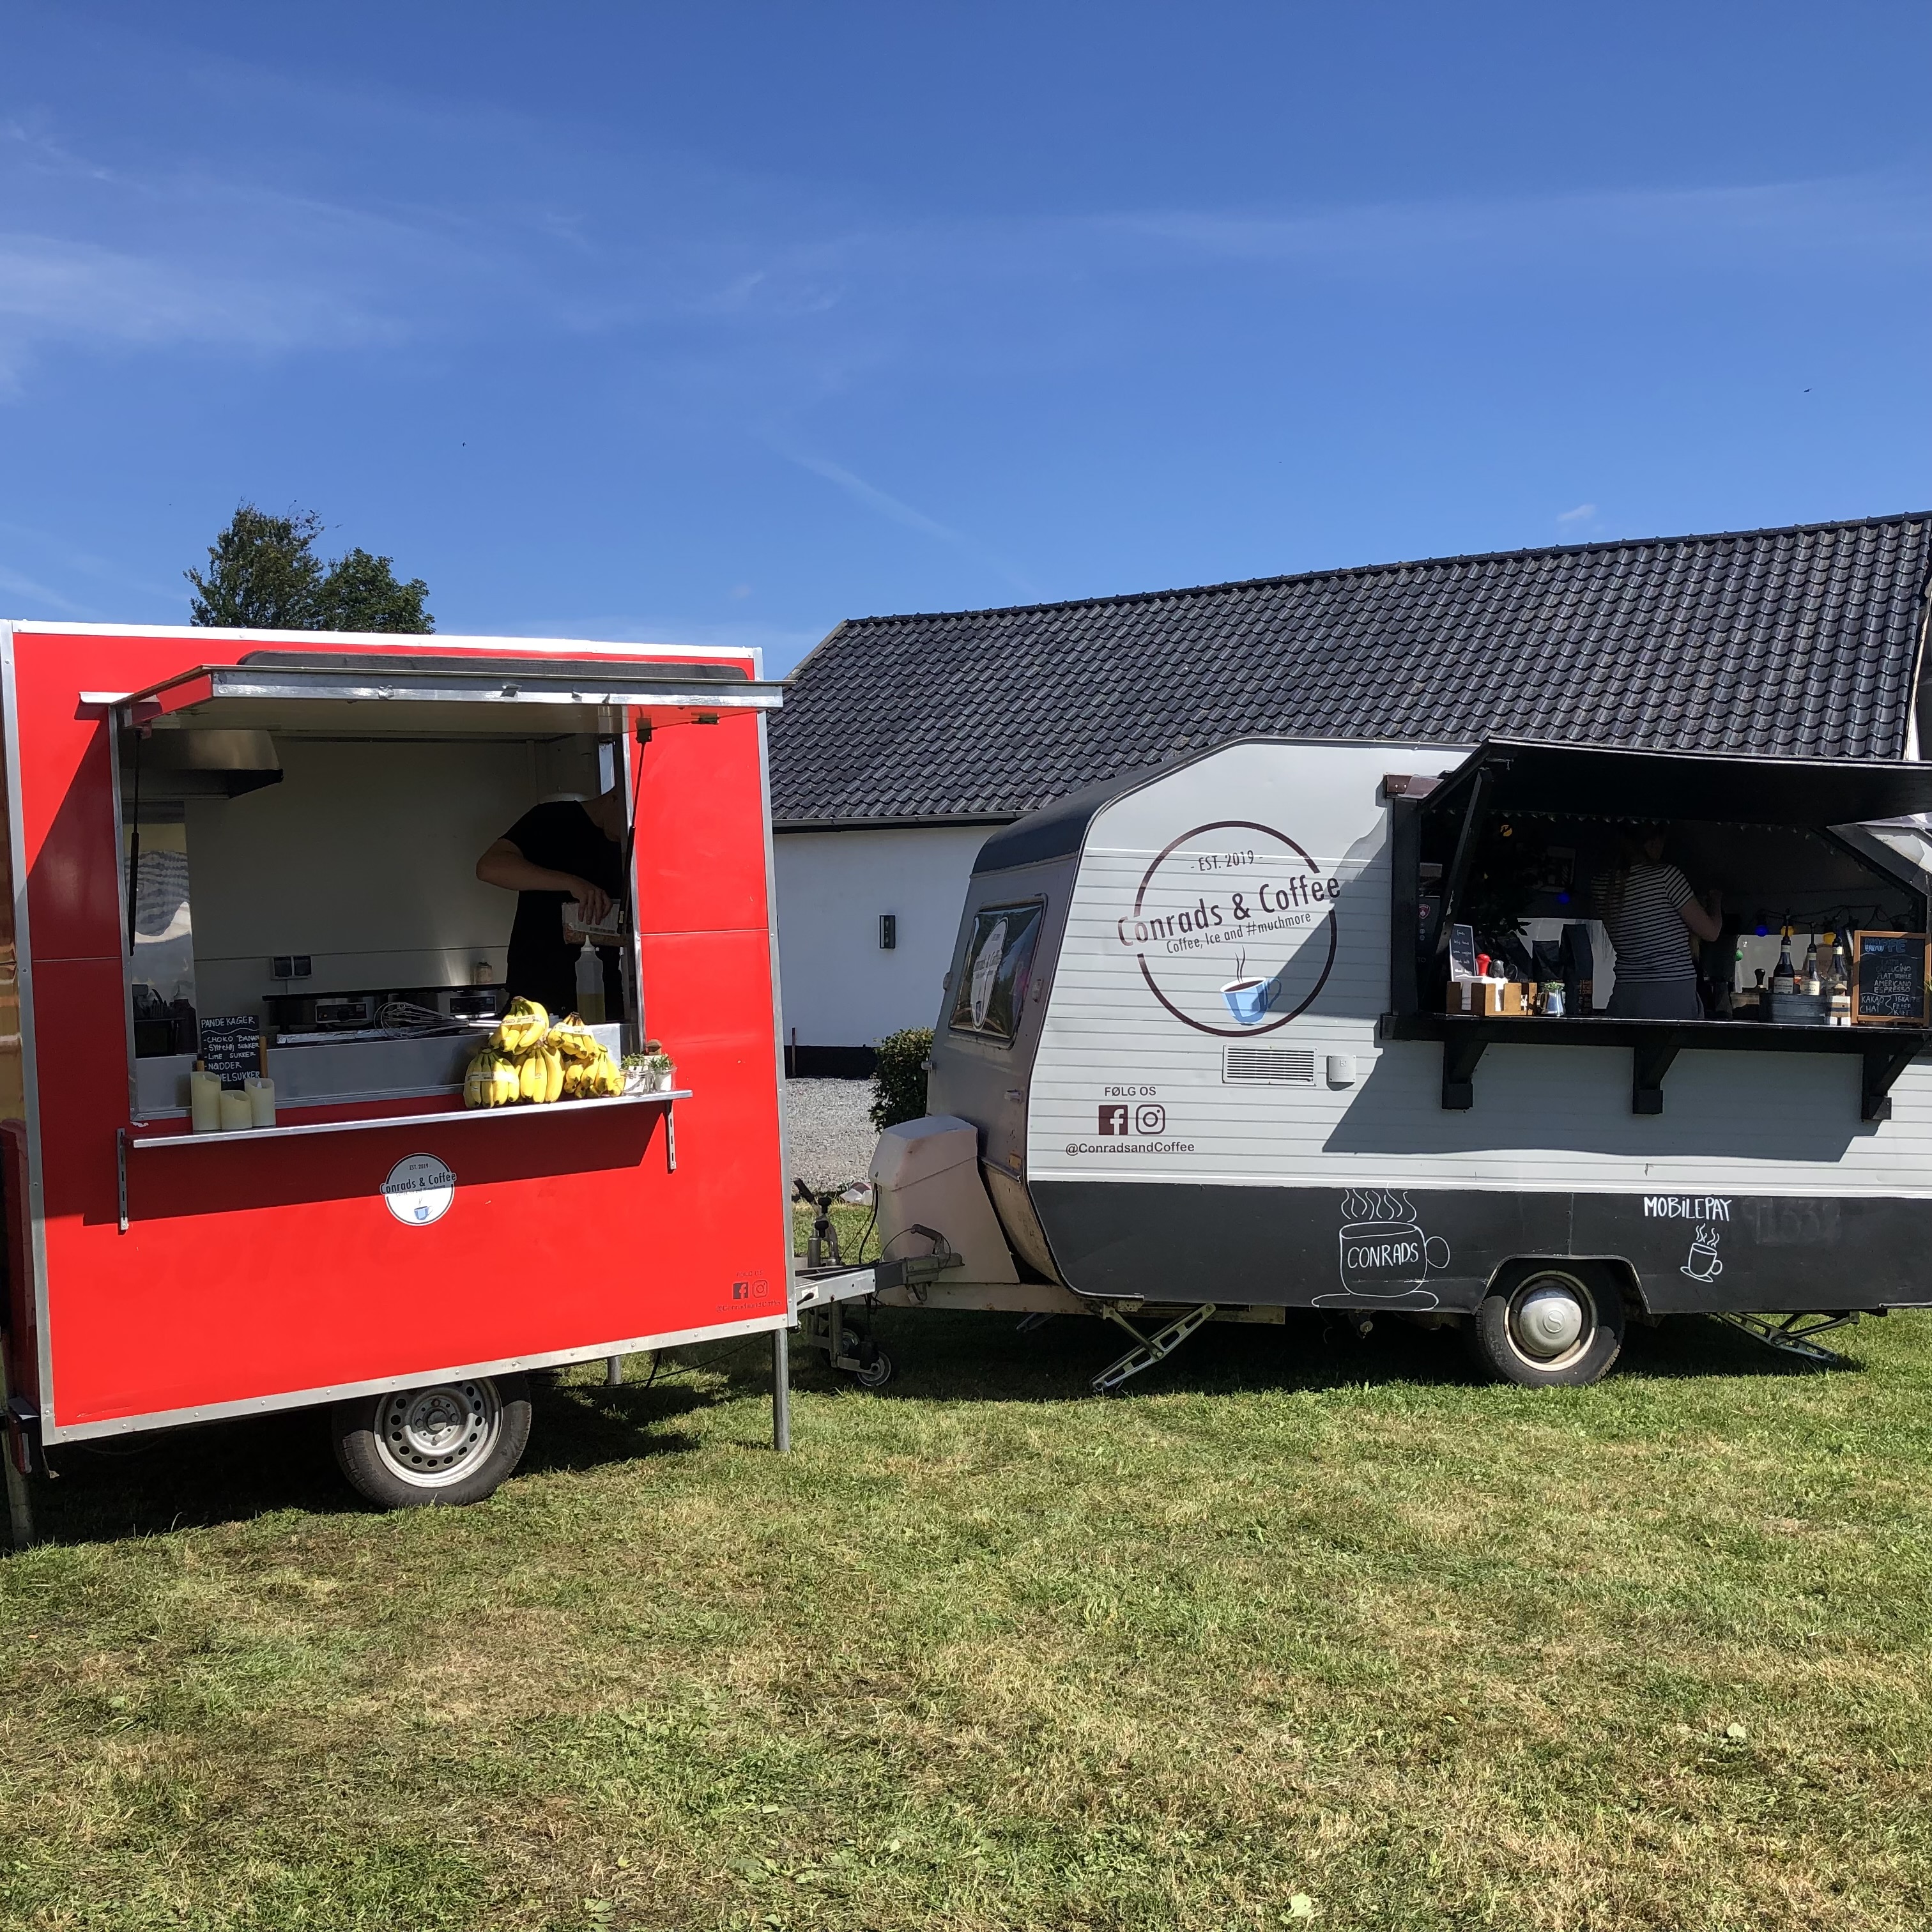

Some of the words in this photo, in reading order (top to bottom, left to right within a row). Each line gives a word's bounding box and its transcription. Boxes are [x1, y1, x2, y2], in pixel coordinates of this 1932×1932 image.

[1198, 855, 1222, 871] EST.
[1225, 850, 1254, 868] 2019
[1117, 898, 1223, 947] Conrads
[1232, 893, 1251, 920] &
[1259, 875, 1340, 914] Coffee
[1167, 937, 1203, 954] Coffee,
[1205, 932, 1221, 946] Ice
[1224, 926, 1243, 941] and
[1246, 913, 1312, 936] #muchmore
[220, 1071, 261, 1082] ELSUKKER
[1105, 1087, 1136, 1096] FØLG
[1140, 1086, 1156, 1096] OS
[1066, 1142, 1195, 1156] @ConradsandCoffee
[380, 1179, 416, 1194] Conrads
[419, 1177, 425, 1187] &
[429, 1172, 456, 1185] Coffee
[1347, 1242, 1420, 1269] CONRADS
